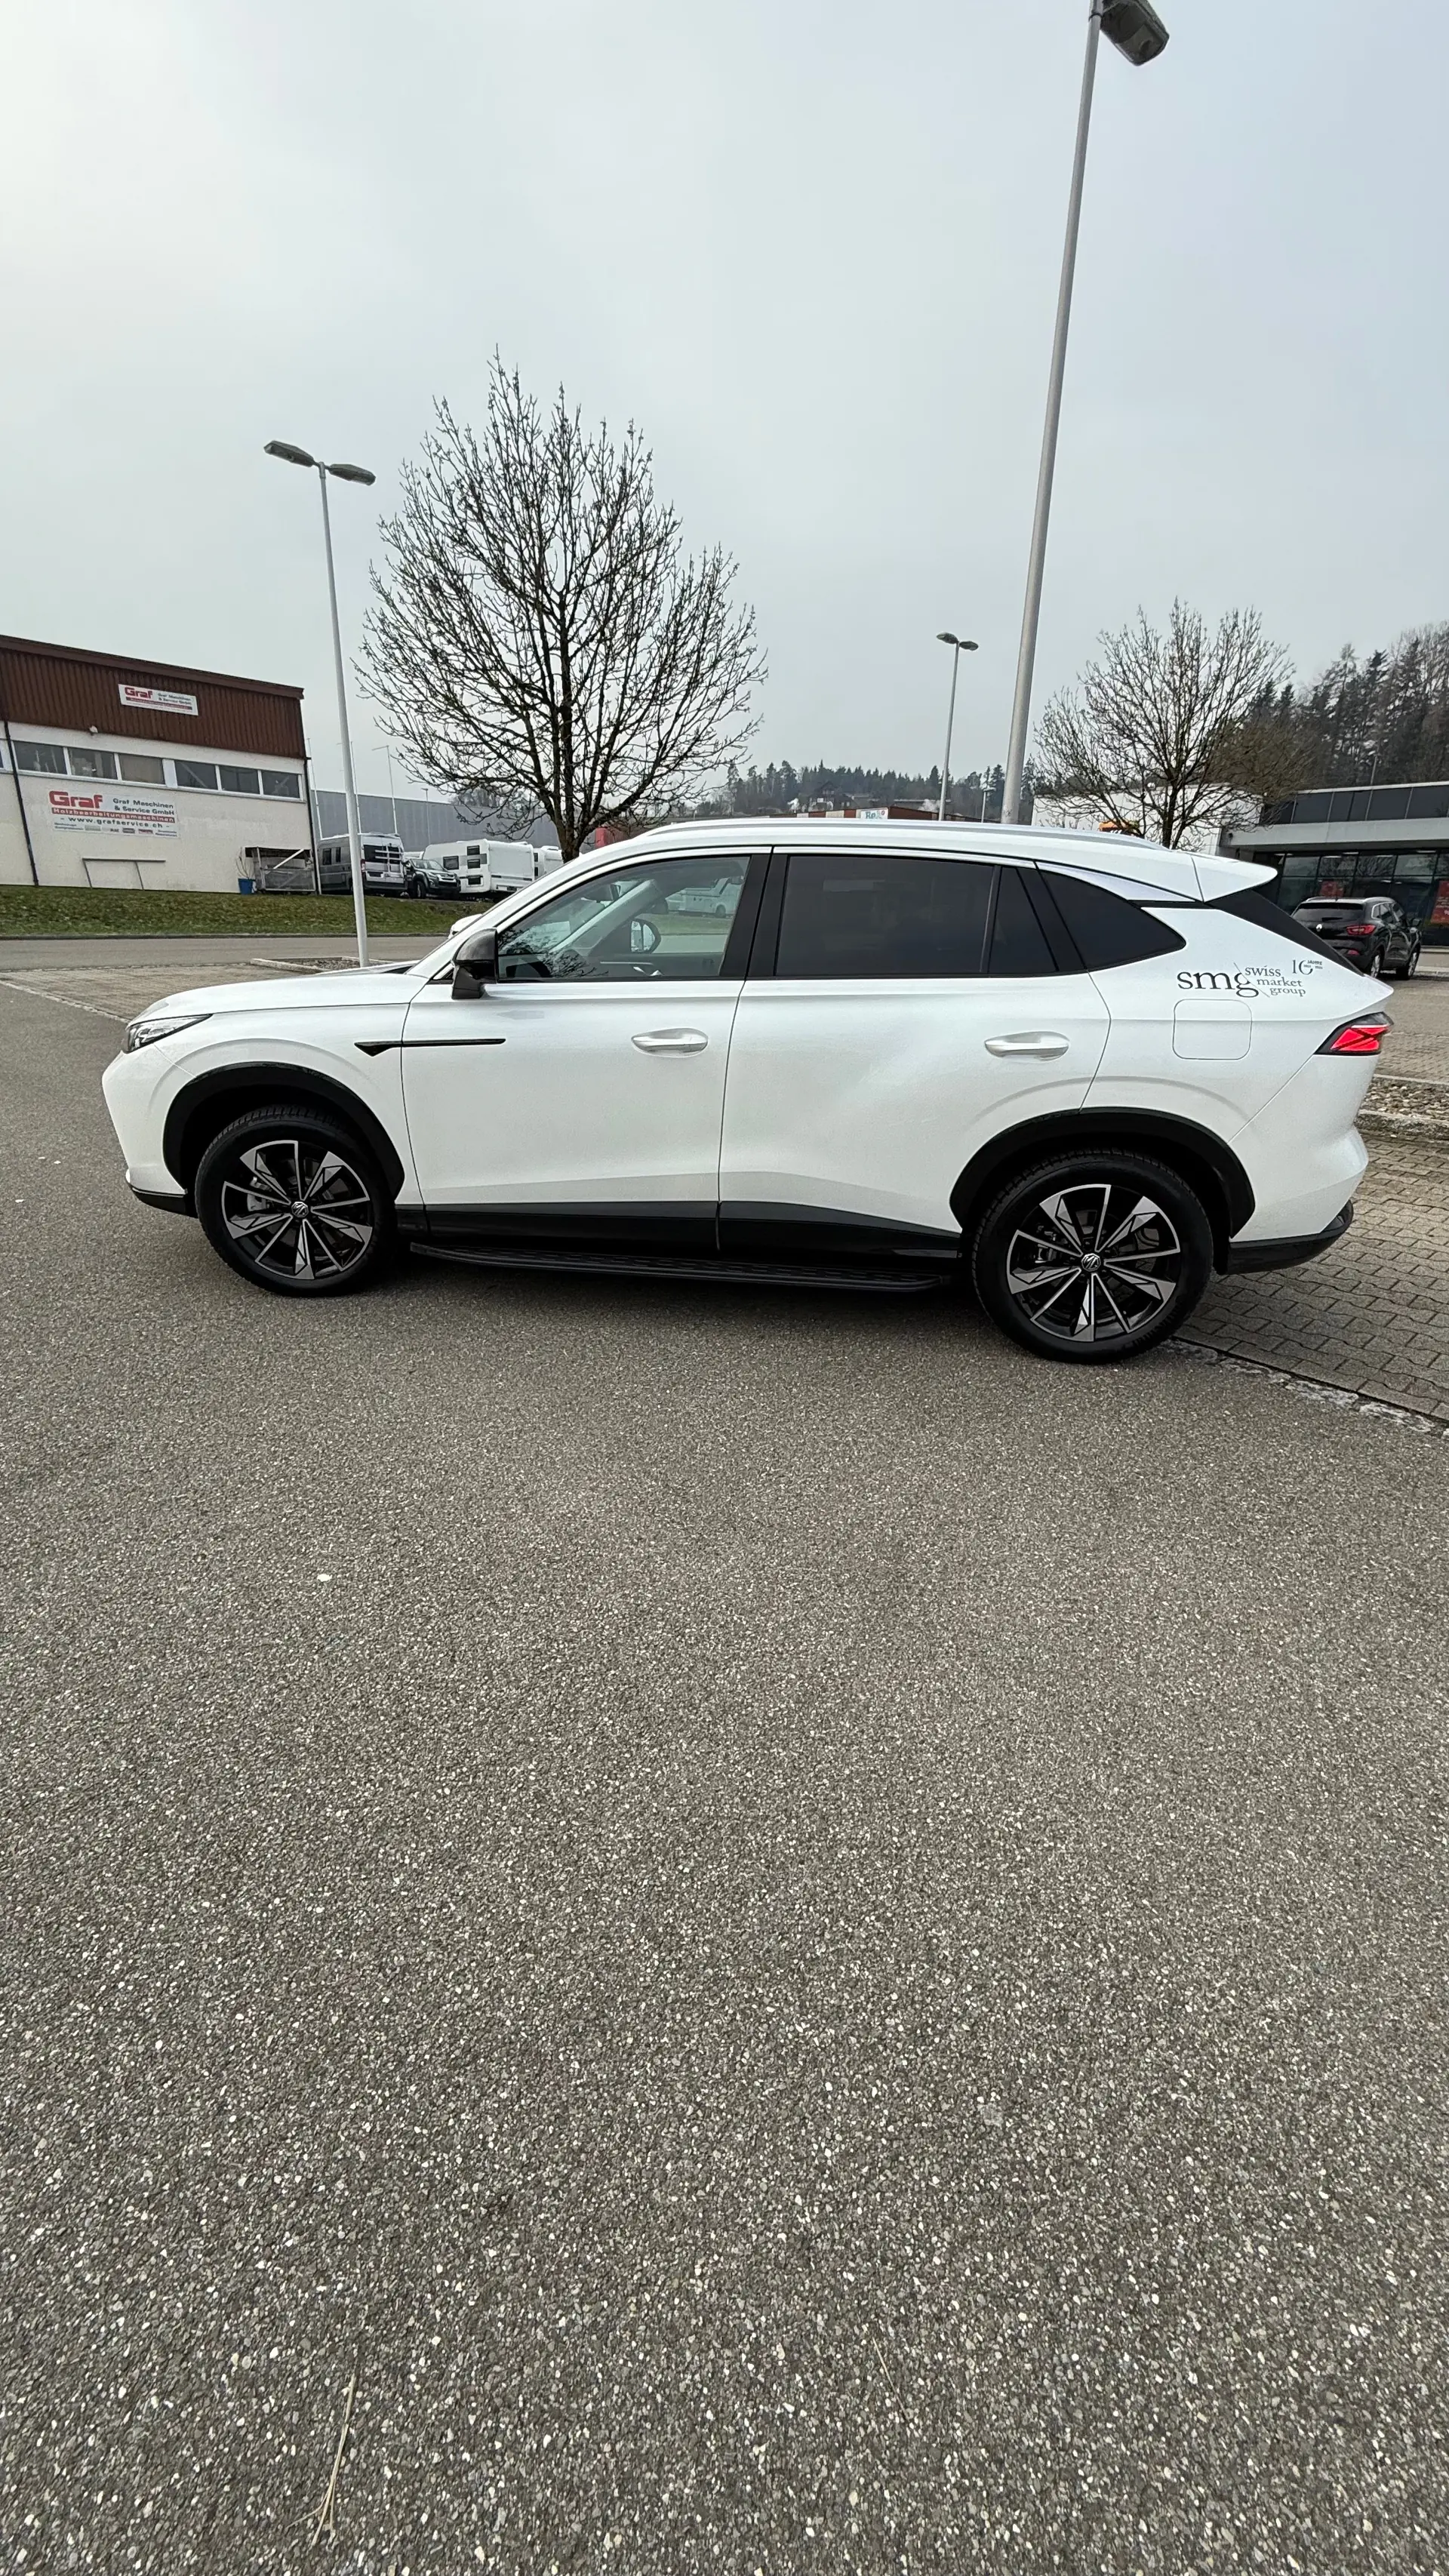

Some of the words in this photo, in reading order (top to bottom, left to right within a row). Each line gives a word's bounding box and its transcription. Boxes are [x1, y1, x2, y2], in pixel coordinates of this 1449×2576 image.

[125, 687, 153, 699] Graf
[49, 790, 103, 808] Graf
[133, 800, 174, 809] Maschinen
[53, 808, 174, 823] Holzbearbeitungsmaschinen
[1244, 965, 1281, 977] swiss
[1177, 971, 1260, 998] smg
[1257, 976, 1303, 987] market
[1269, 986, 1306, 997] group
